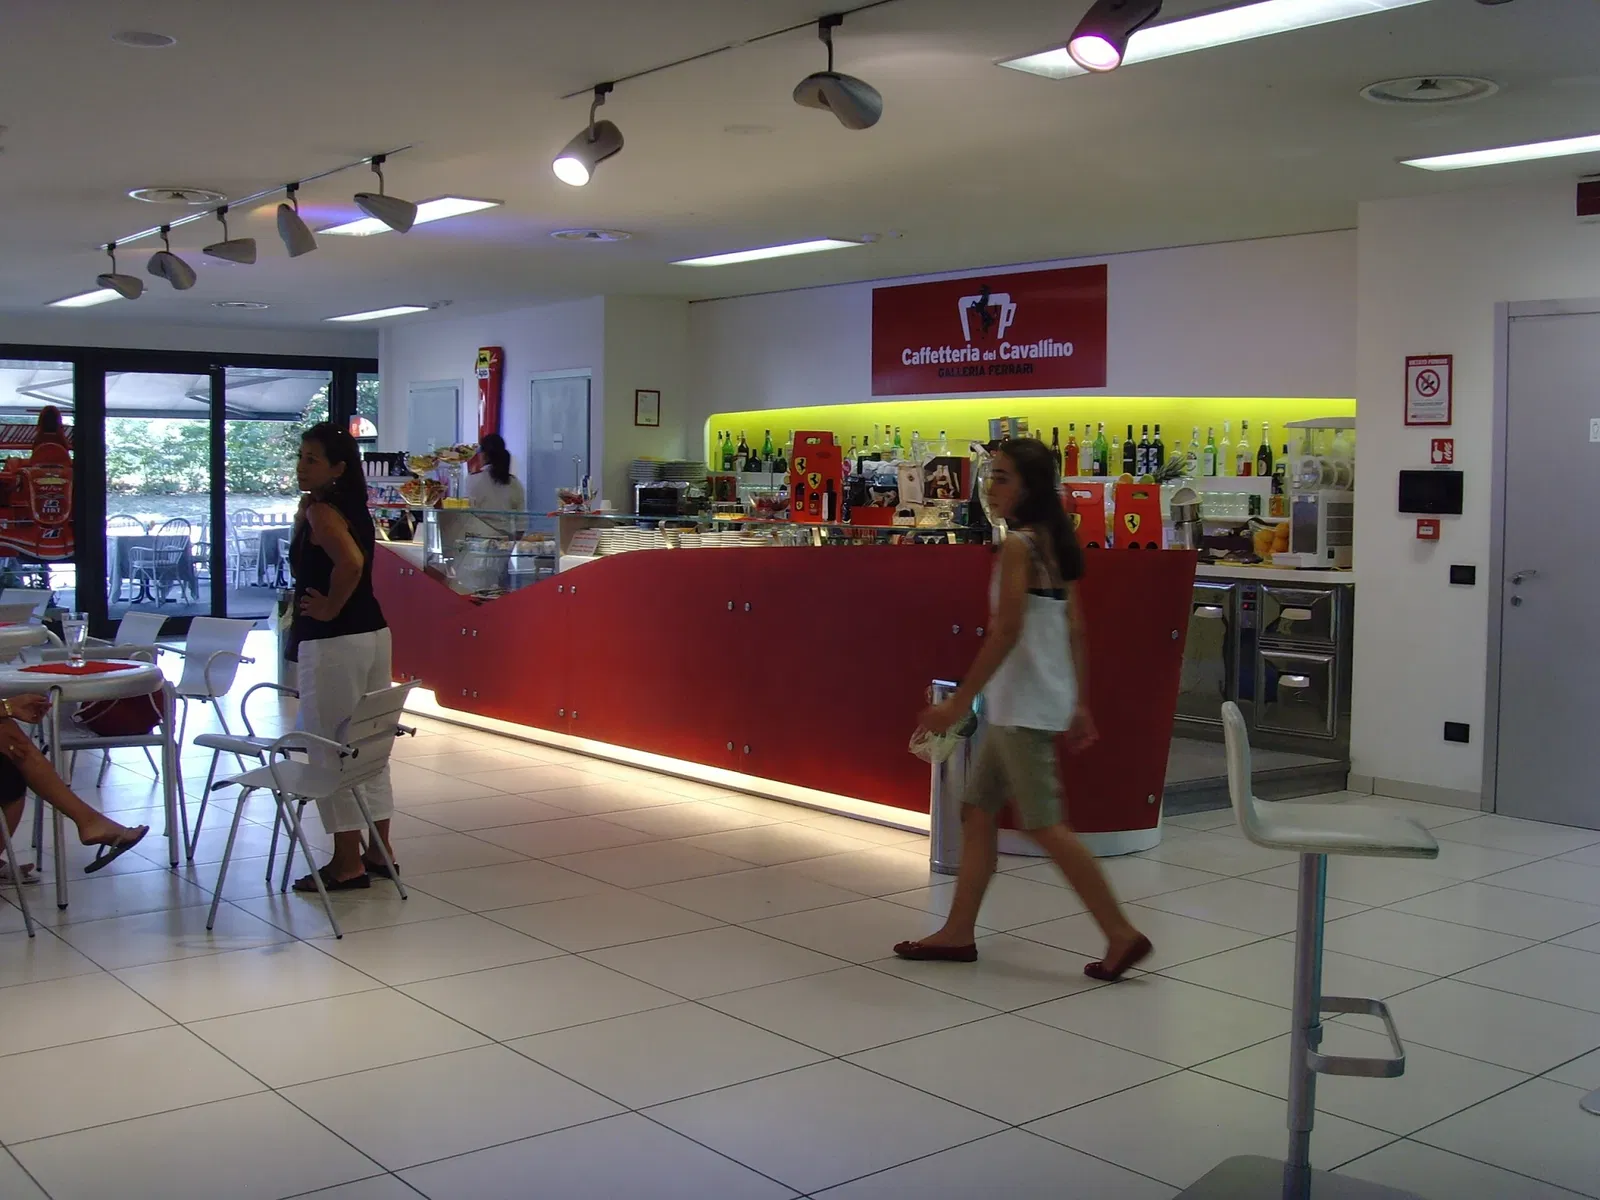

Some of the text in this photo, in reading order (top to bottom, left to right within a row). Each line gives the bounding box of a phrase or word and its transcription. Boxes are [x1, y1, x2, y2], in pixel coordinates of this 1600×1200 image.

[902, 338, 1073, 365] Caffetteria del Cavallino
[938, 363, 1033, 378] GALLERIA FERRARI
